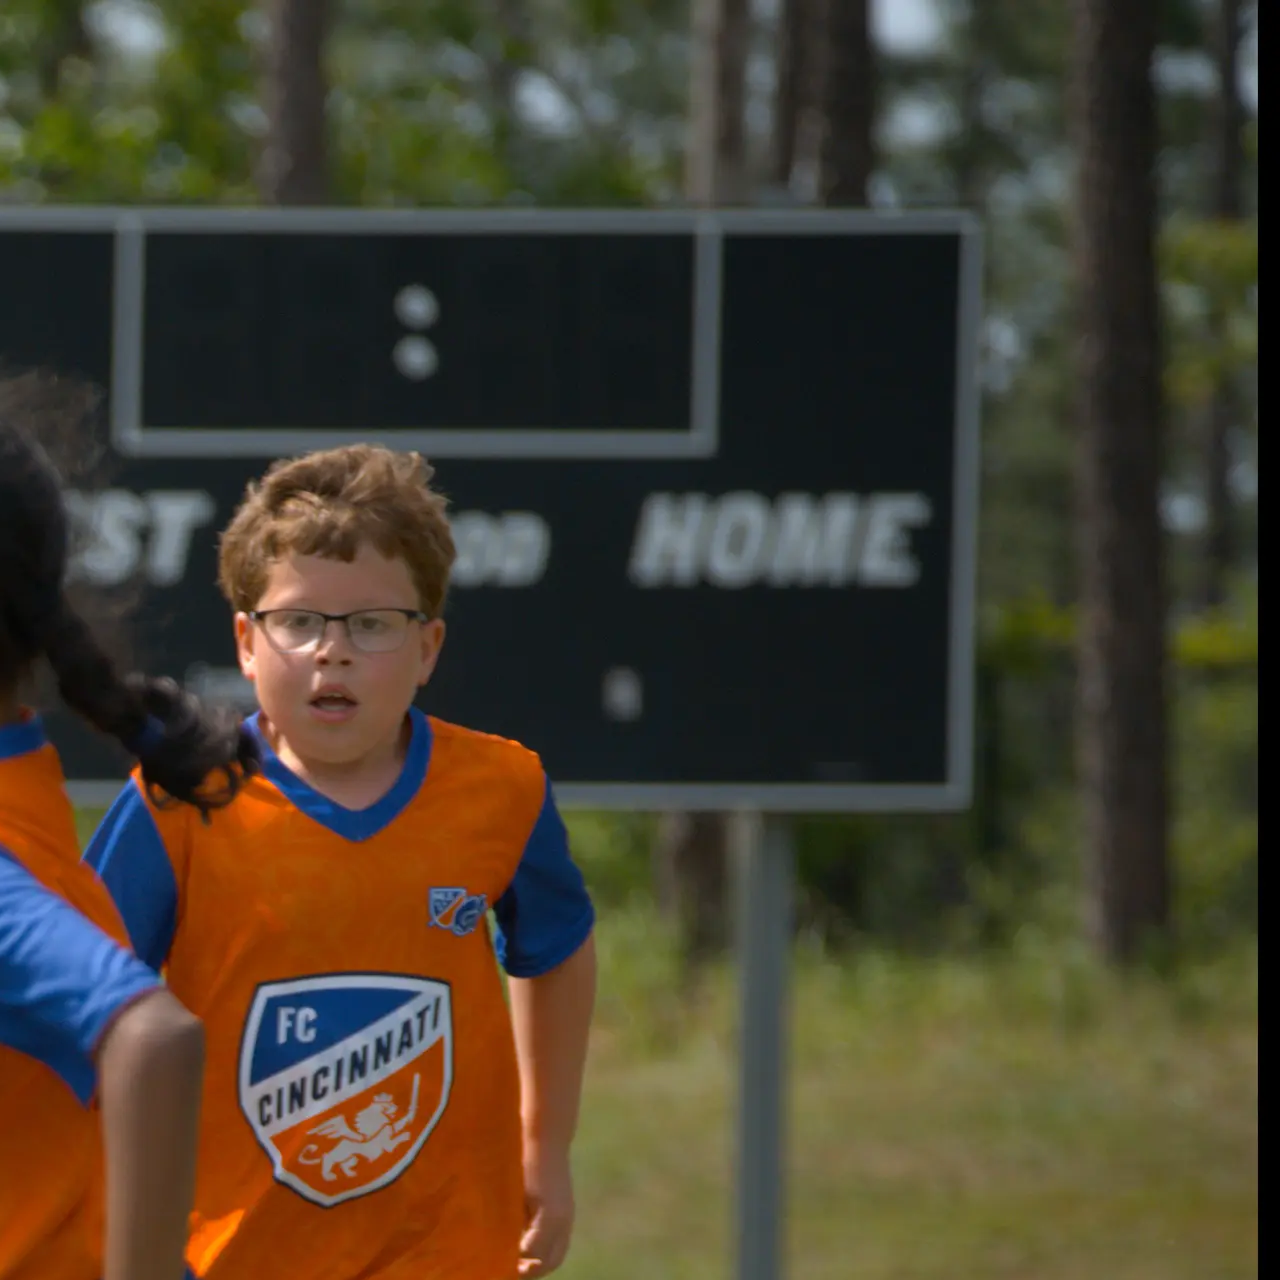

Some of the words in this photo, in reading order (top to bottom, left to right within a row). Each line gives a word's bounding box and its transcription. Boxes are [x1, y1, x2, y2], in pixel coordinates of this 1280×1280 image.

[629, 490, 932, 588] HOME
[257, 997, 440, 1128] CINCINNATI
[276, 1006, 318, 1045] FC
